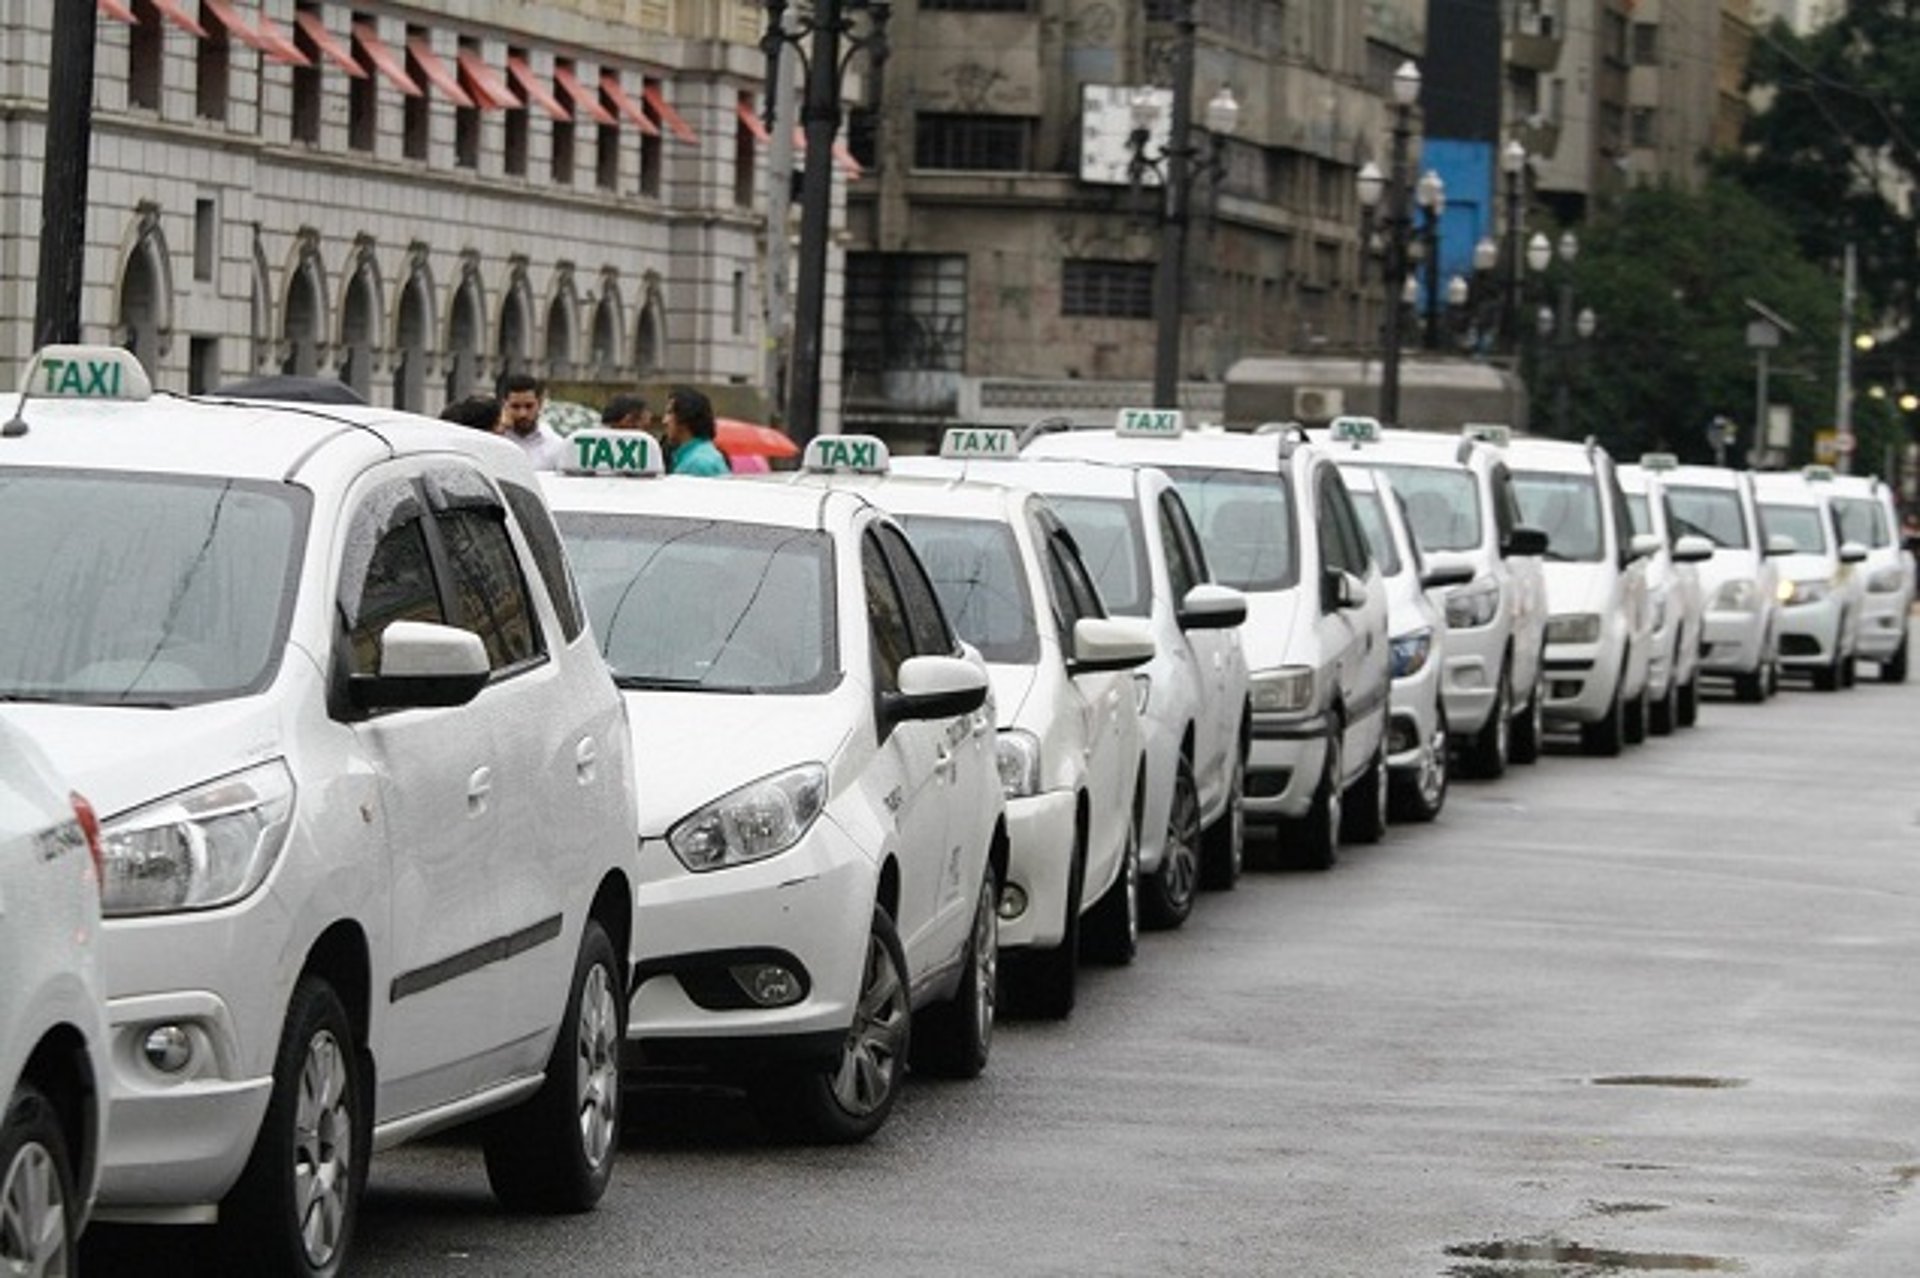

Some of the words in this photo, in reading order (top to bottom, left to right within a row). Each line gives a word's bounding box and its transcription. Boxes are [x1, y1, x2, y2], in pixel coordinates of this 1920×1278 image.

[42, 359, 120, 395] TAXI
[1125, 413, 1176, 430] TAXI
[574, 437, 648, 469] TAXI
[816, 440, 876, 468] TAXI
[950, 431, 1007, 452] TAXI
